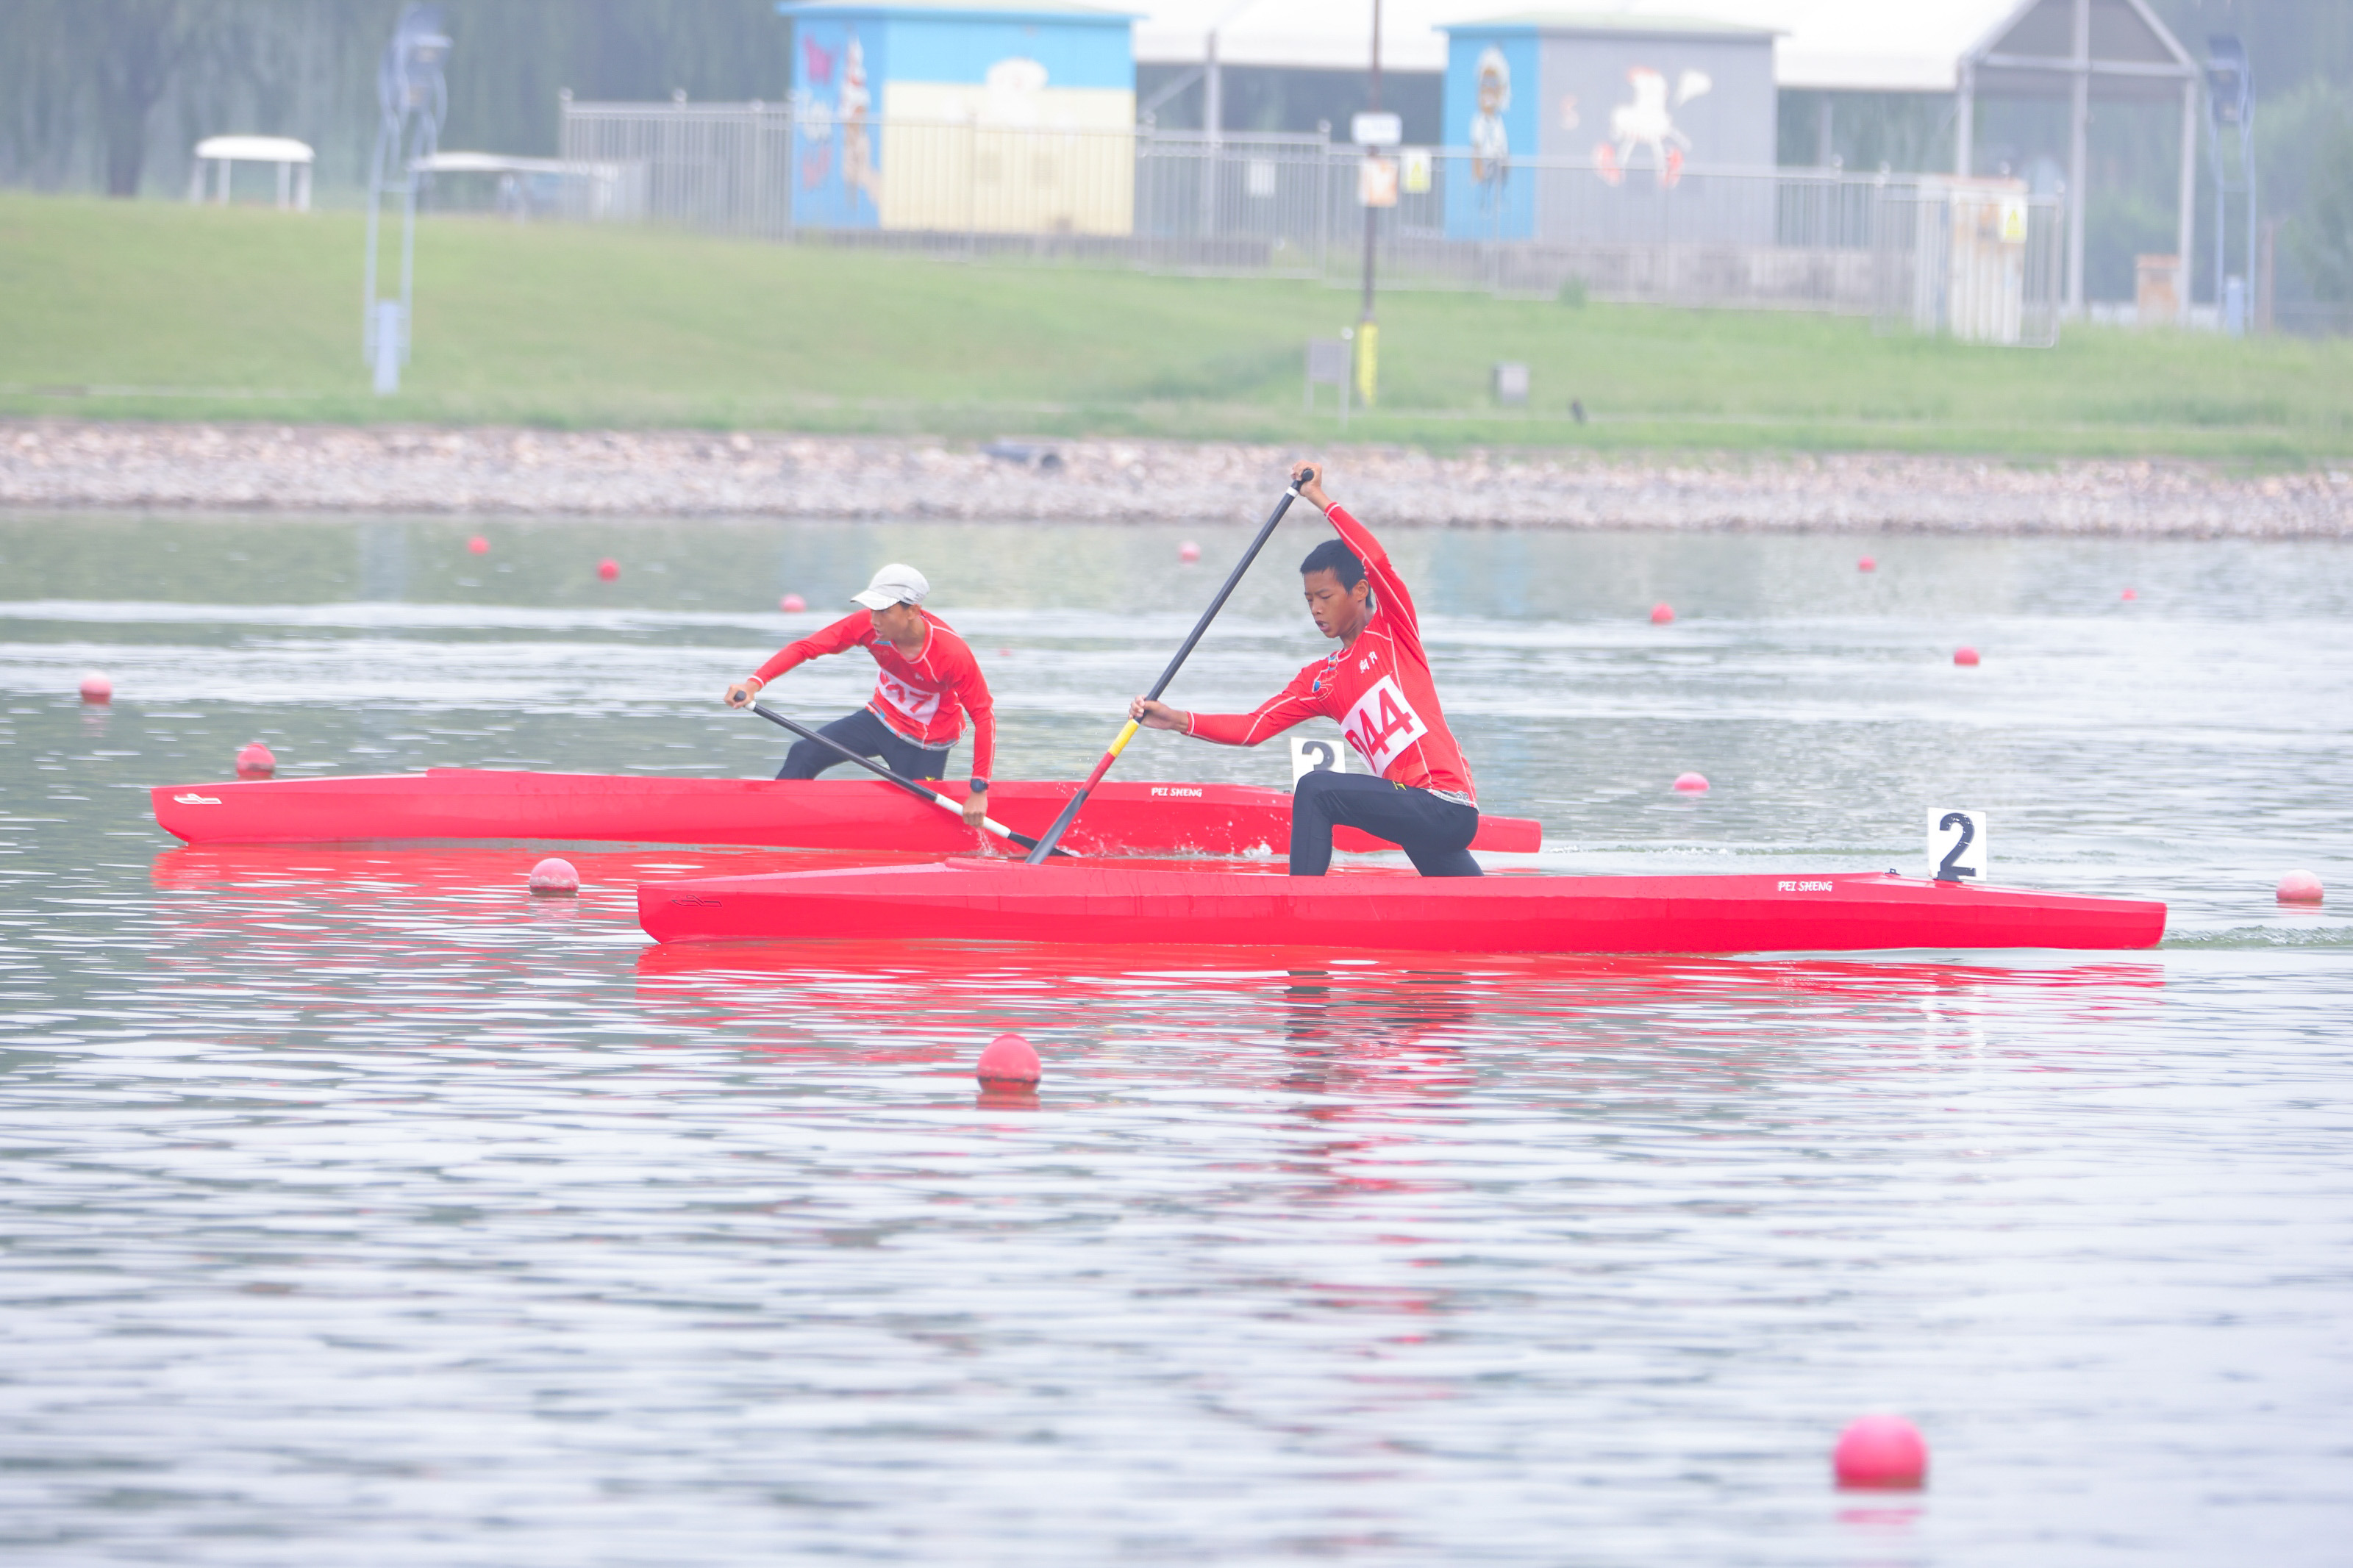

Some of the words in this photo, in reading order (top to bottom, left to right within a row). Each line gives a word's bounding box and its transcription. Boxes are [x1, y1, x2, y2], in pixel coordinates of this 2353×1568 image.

[1151, 787, 1168, 797] PEI
[1170, 788, 1202, 798] SHENG
[1940, 812, 1977, 877] 2
[1779, 881, 1797, 892] PEI
[1799, 881, 1833, 892] SHENG
